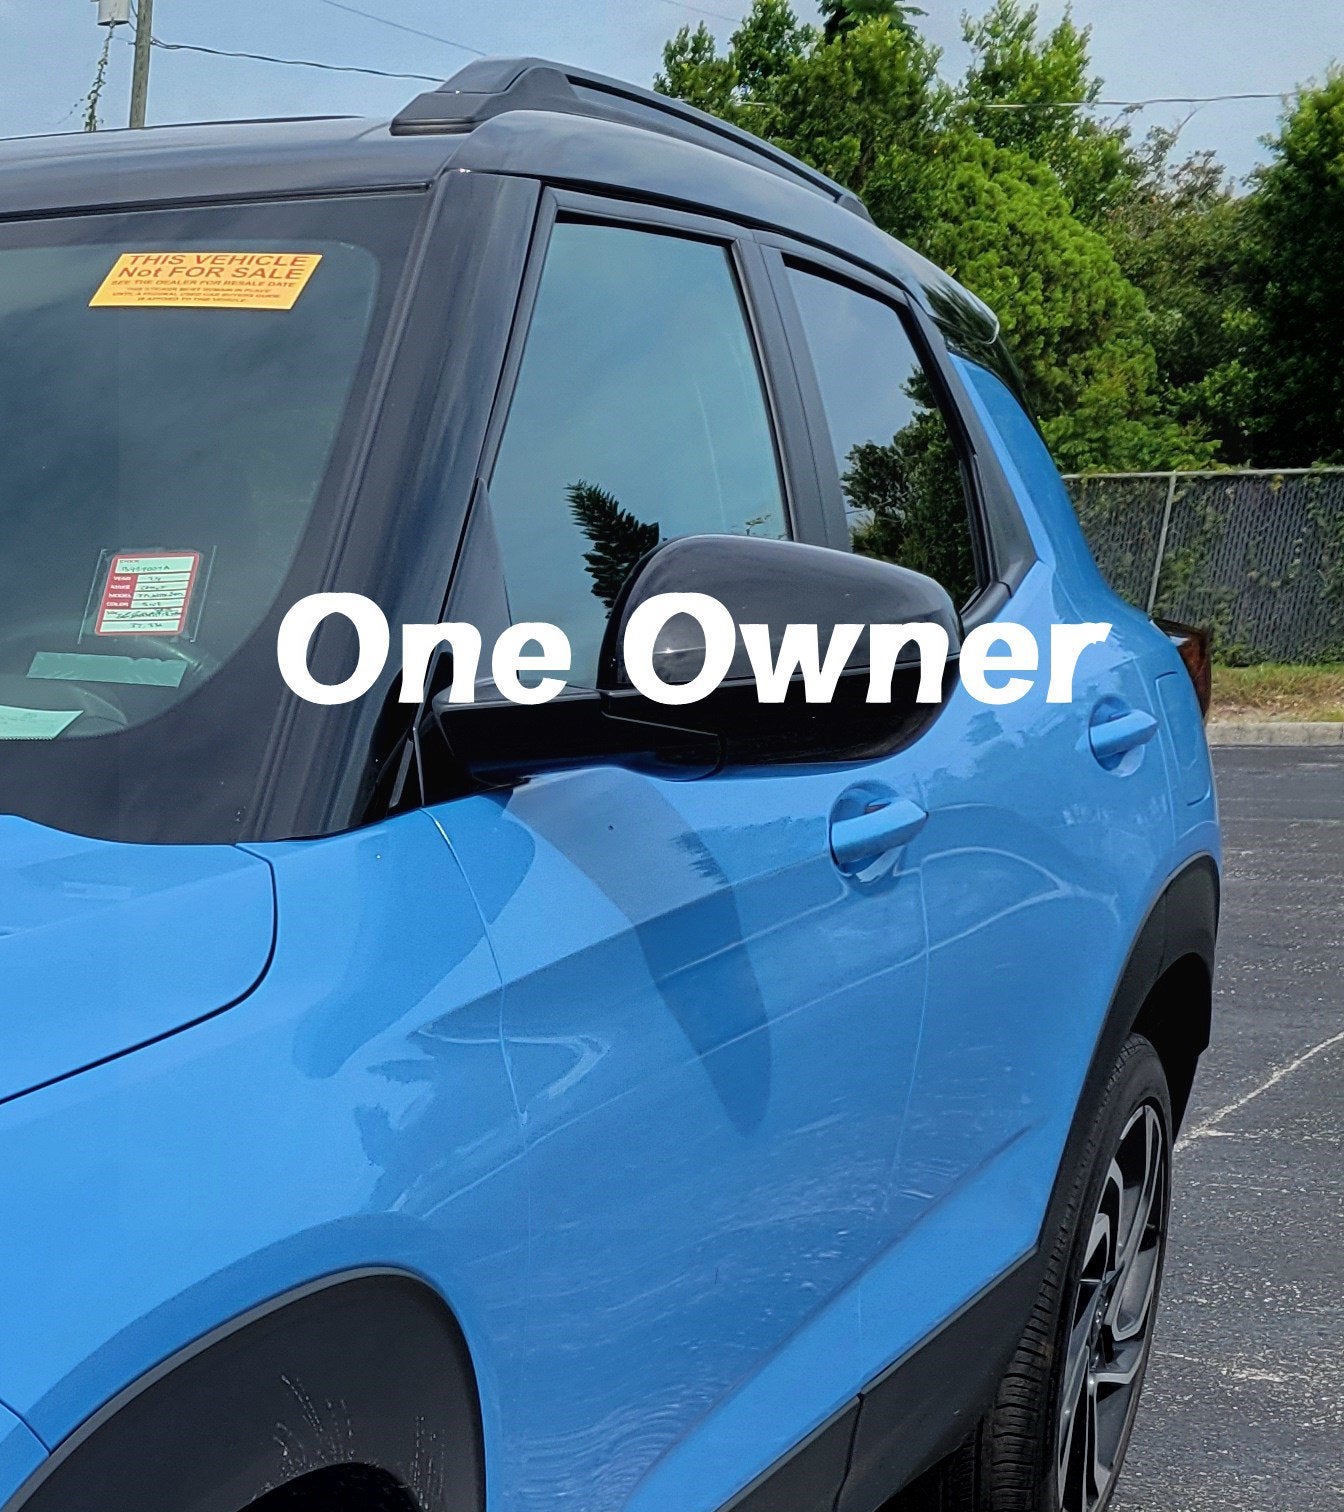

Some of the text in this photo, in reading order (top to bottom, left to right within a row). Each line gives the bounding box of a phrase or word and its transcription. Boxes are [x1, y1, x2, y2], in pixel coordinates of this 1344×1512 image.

[129, 254, 311, 267] THIS VEHICLE
[117, 266, 305, 280] Not FOR SALE
[199, 279, 223, 287] FOR
